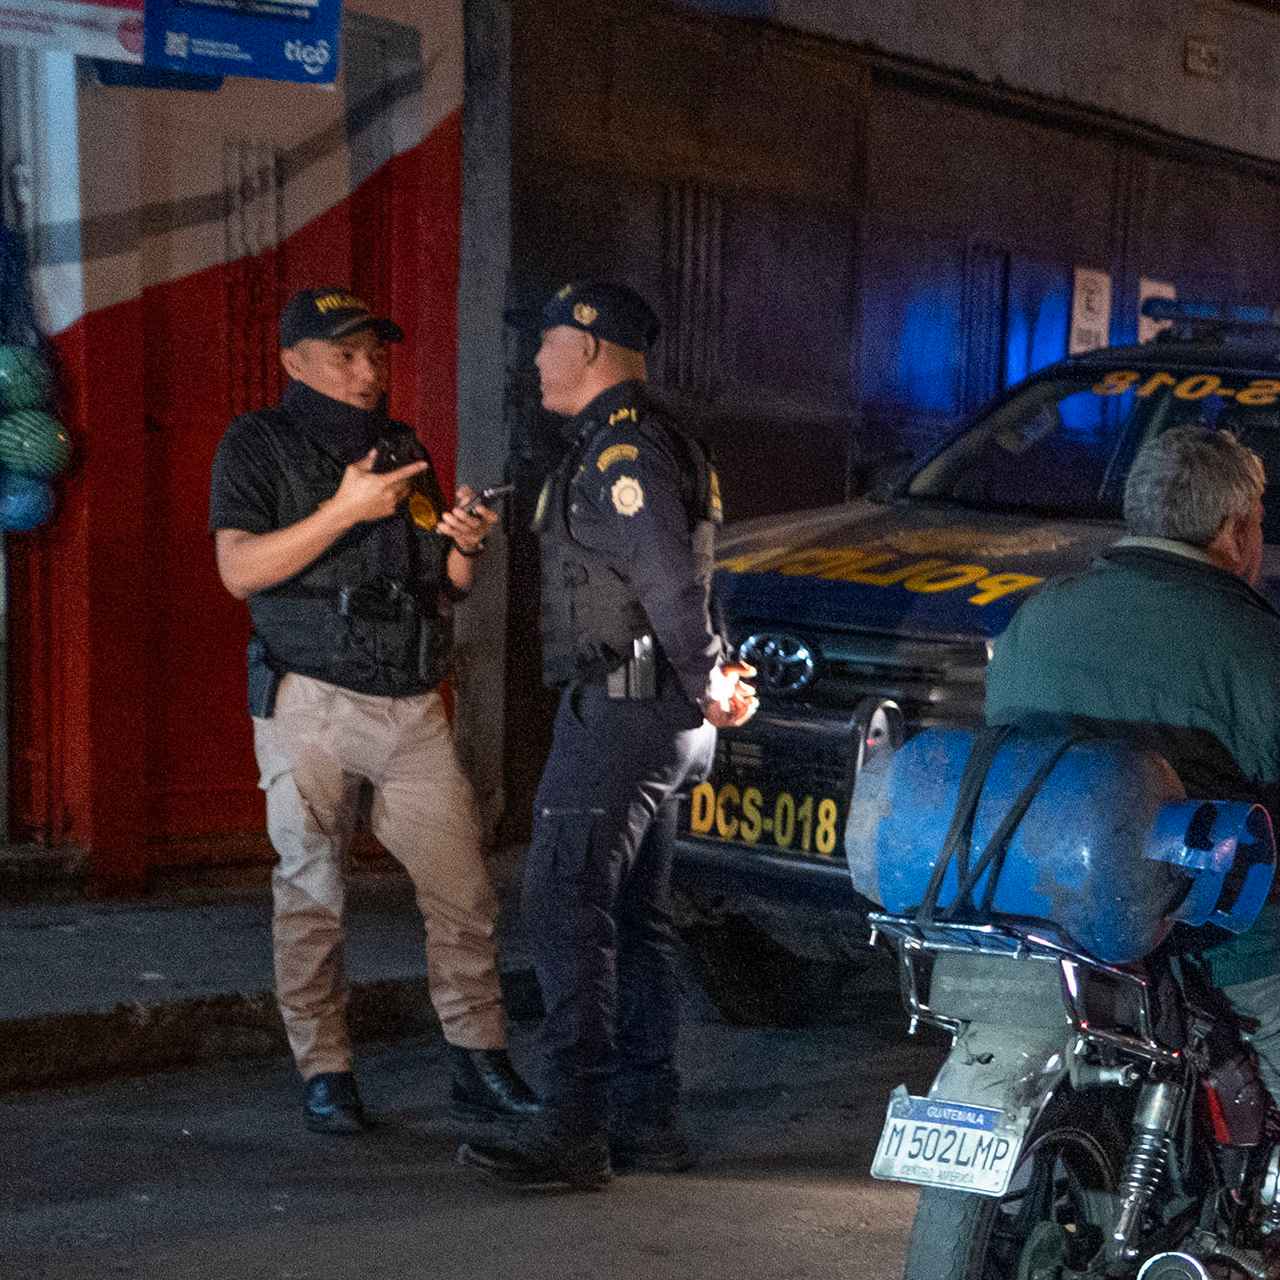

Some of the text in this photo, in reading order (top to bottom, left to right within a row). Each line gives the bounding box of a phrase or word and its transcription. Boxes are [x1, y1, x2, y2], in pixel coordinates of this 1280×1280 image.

[284, 38, 331, 75] tigo
[690, 782, 838, 855] DCS-018
[926, 1106, 986, 1126] GUATEMALA
